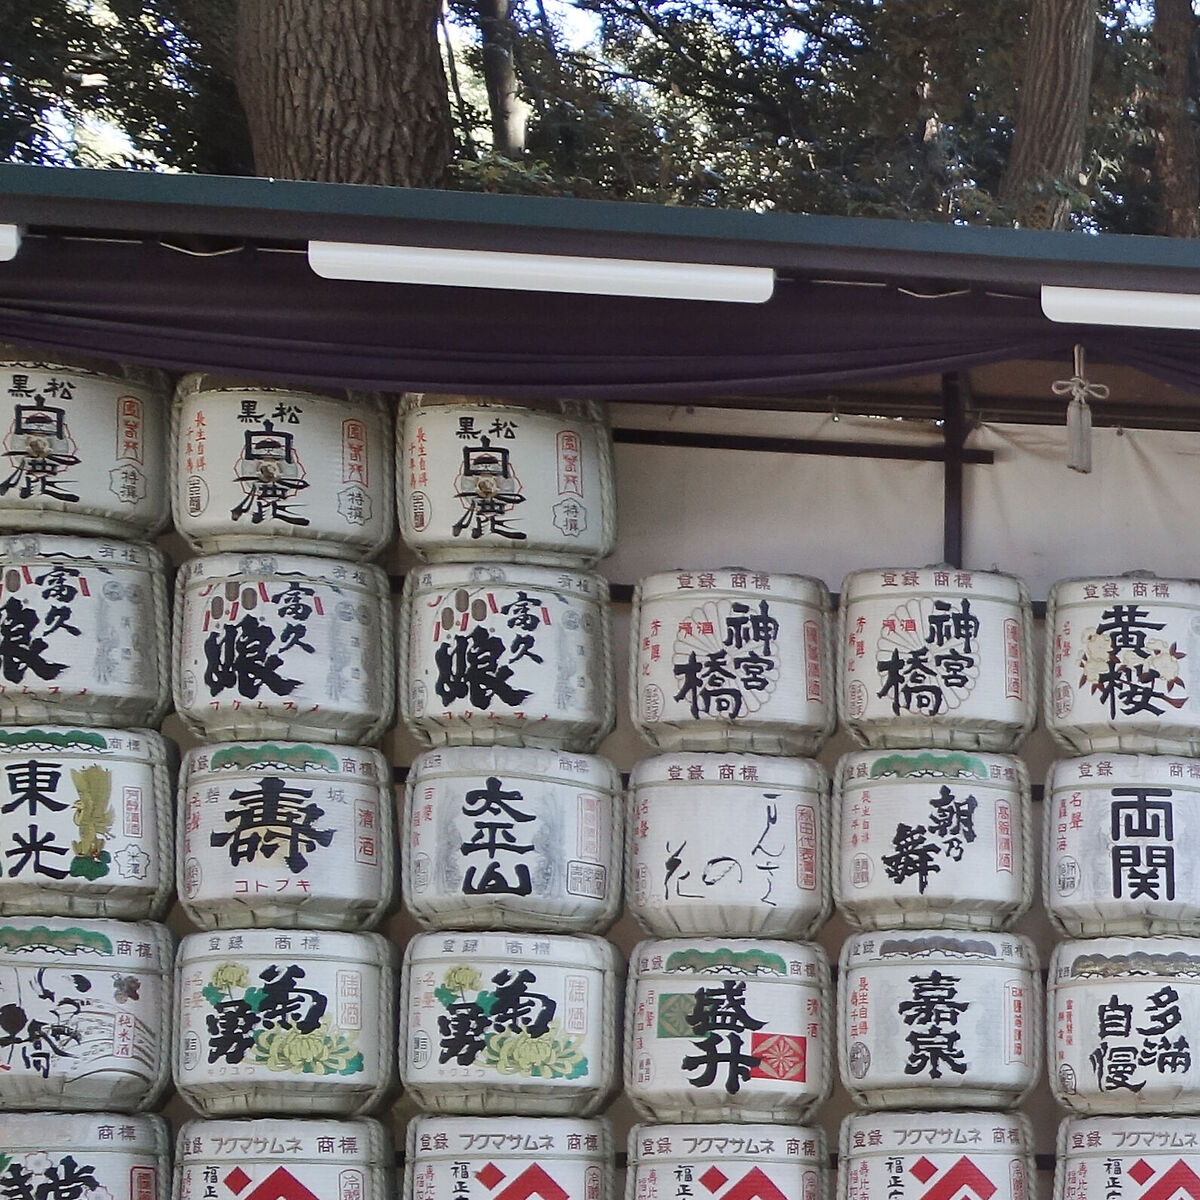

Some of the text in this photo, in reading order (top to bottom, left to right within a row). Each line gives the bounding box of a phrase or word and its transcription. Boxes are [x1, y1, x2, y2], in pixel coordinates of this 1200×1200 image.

[8, 375, 76, 399] 黒松
[238, 401, 301, 424] 黒松
[456, 417, 520, 439] 黒松
[0, 394, 81, 502] 白鹿
[231, 420, 310, 526] 白鹿
[452, 436, 527, 539] 白鹿
[204, 582, 315, 699] 富久娘
[435, 591, 544, 710] 富久娘
[2, 761, 70, 880] 東光
[359, 809, 374, 855] 清酒
[461, 777, 536, 897] 太平山
[1111, 788, 1175, 900] 両関
[235, 880, 310, 892] コトブキ
[117, 1016, 130, 1056] 純米酒
[681, 981, 768, 1094] 盛升
[899, 970, 969, 1079] 嘉泉
[211, 1137, 303, 1154] フクマサムネ
[460, 1134, 555, 1151] フクマサムネ
[683, 1138, 775, 1155] フクマサムネ
[895, 1129, 981, 1145] フクマサムネ
[1112, 1132, 1196, 1147] フクマサムネ
